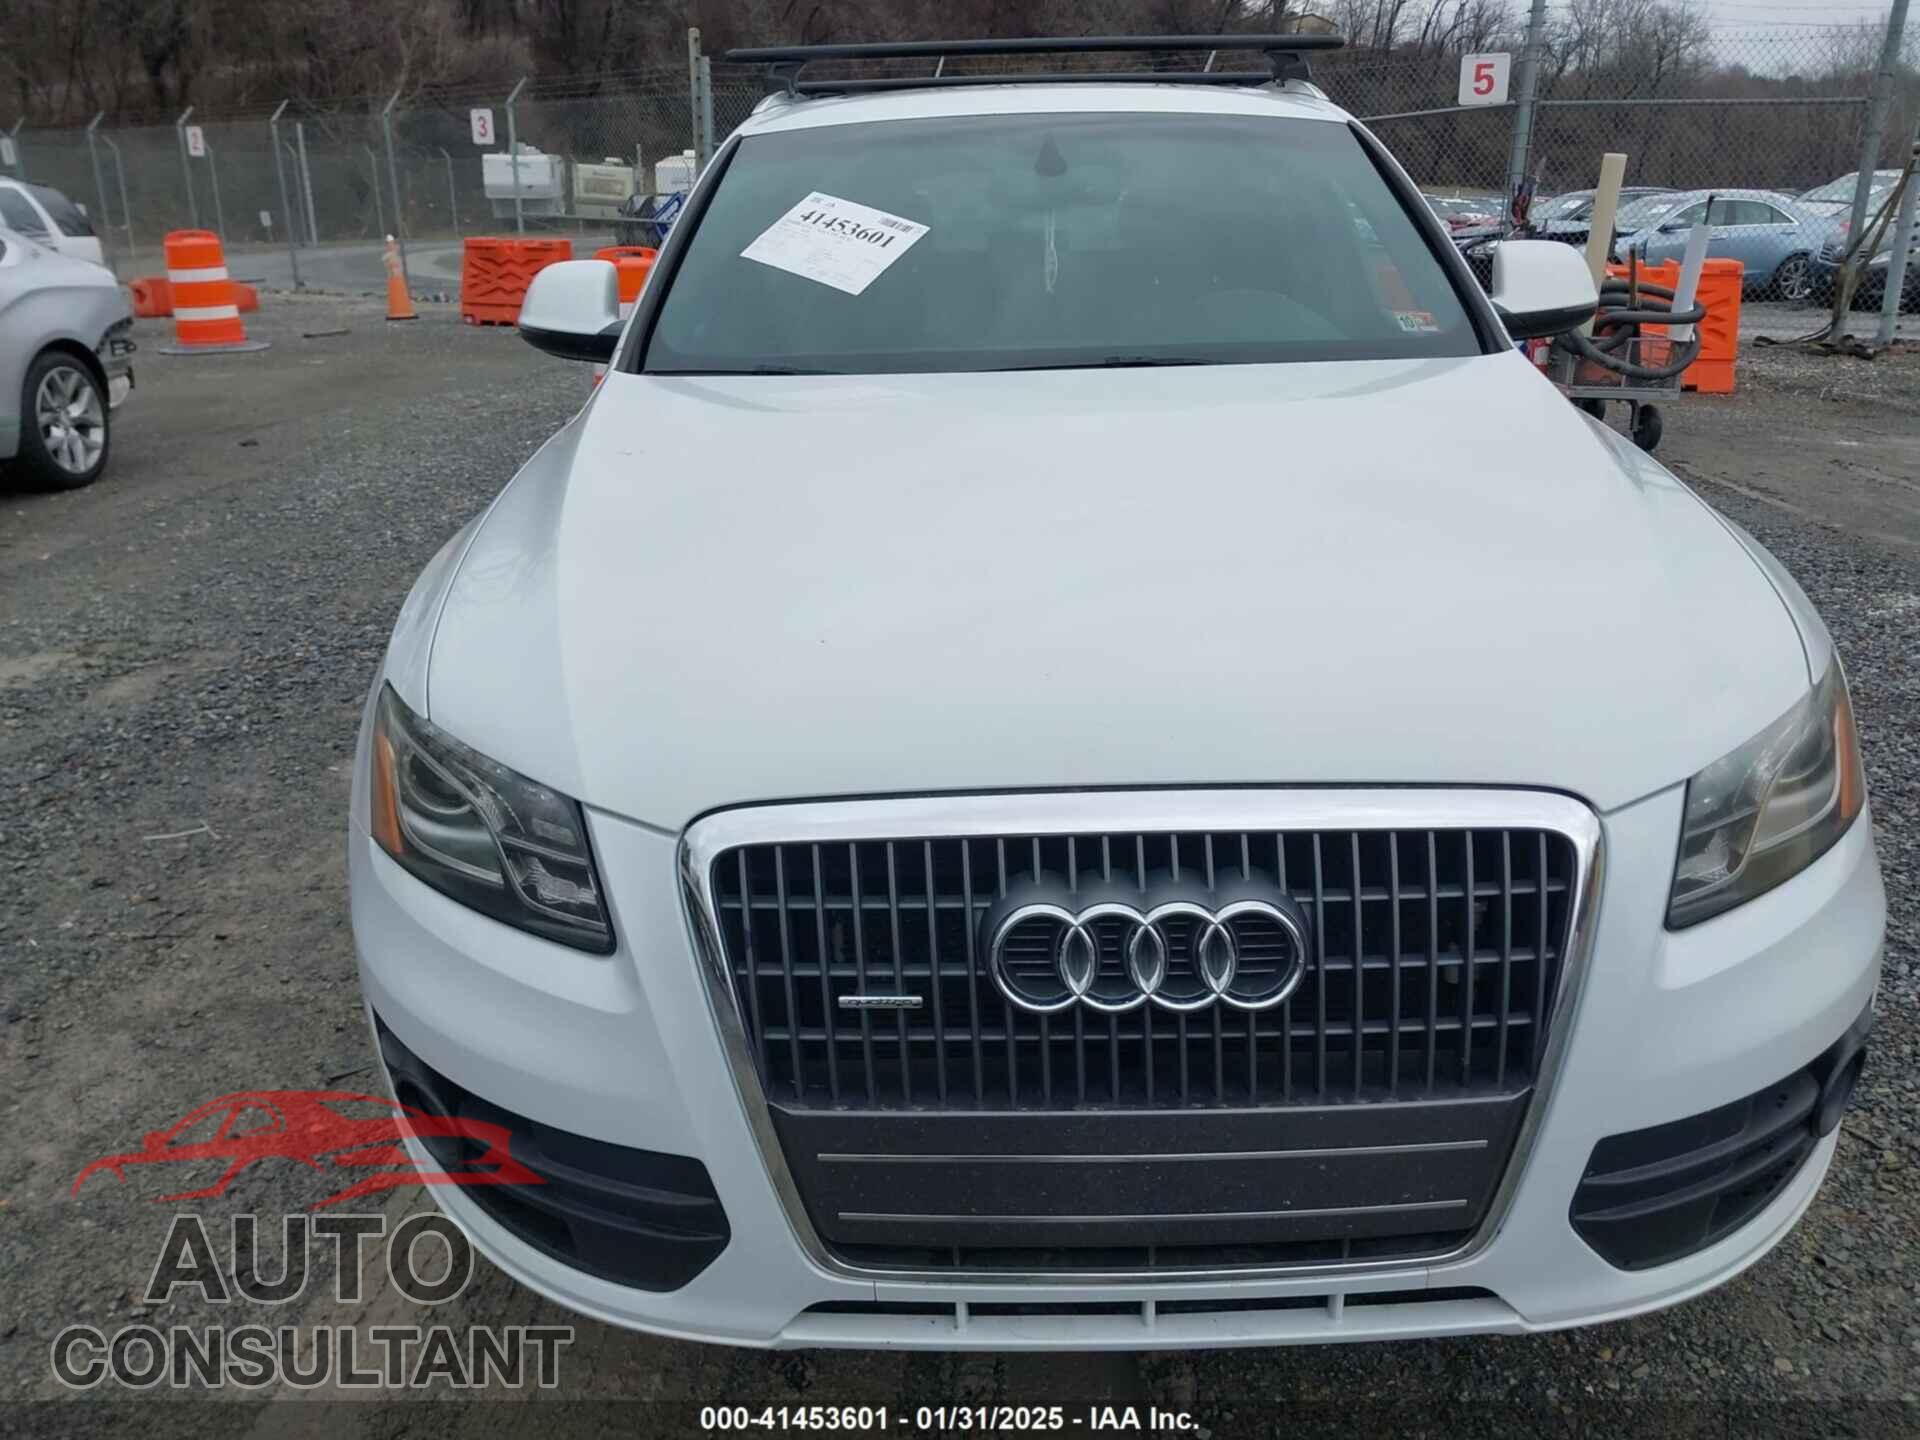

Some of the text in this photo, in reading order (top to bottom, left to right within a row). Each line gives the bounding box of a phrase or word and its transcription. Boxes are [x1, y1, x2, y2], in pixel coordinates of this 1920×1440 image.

[1473, 63, 1495, 96] 5
[478, 116, 488, 138] 3
[800, 210, 895, 248] 41453601
